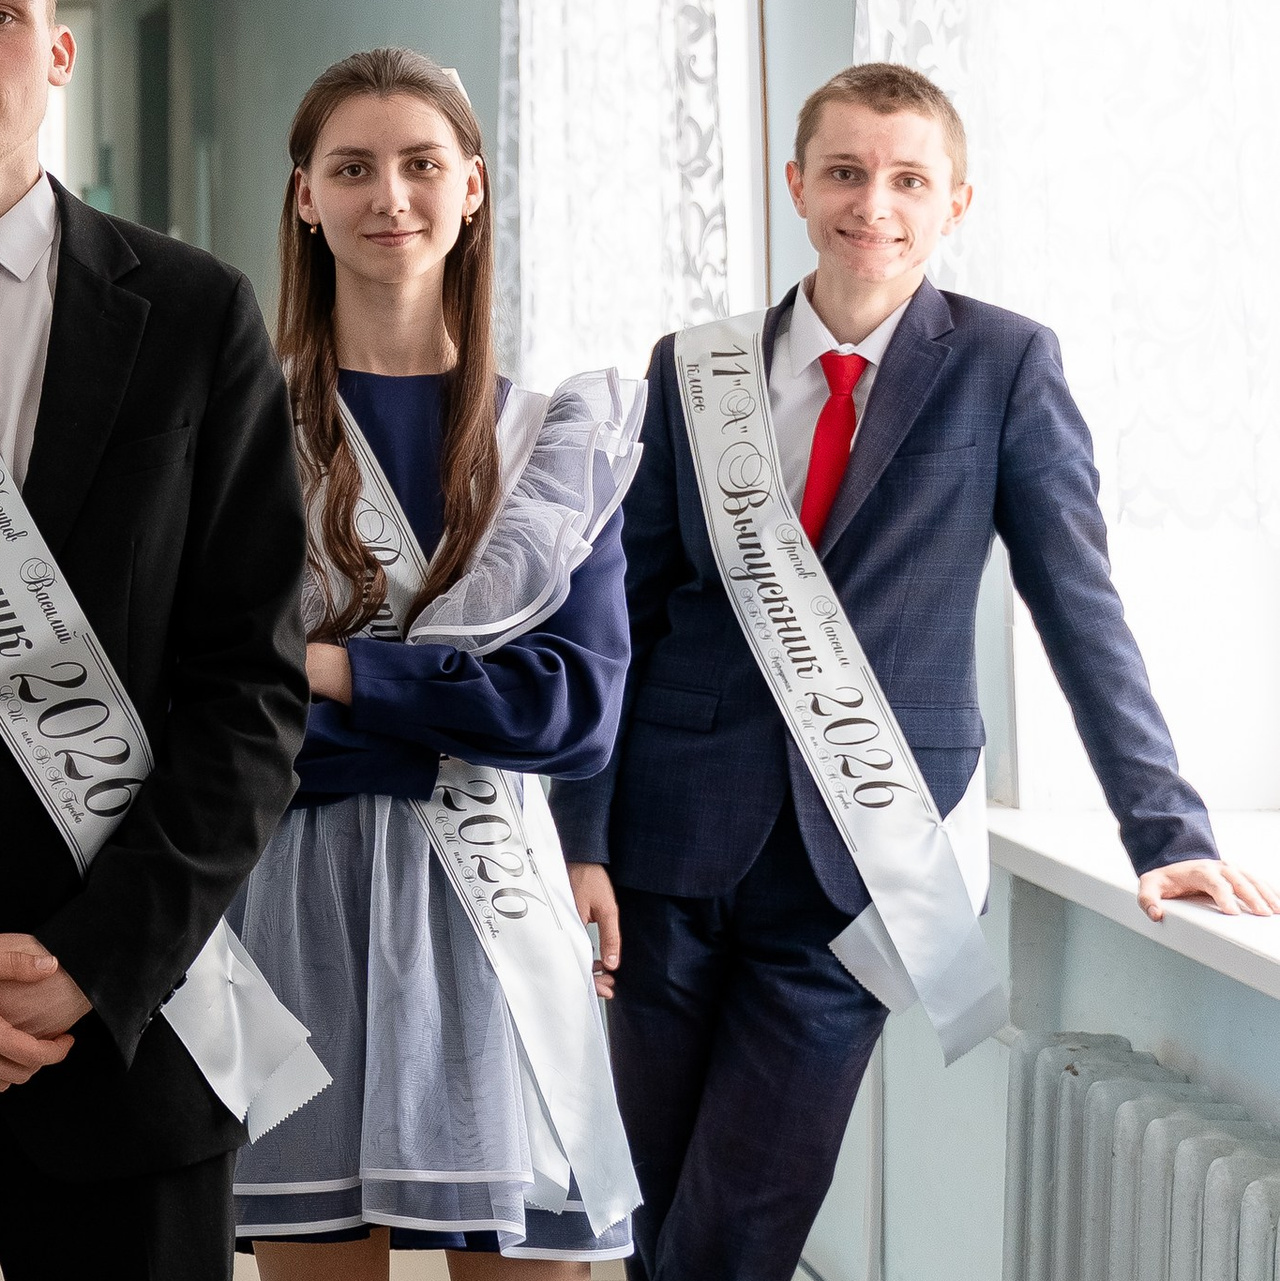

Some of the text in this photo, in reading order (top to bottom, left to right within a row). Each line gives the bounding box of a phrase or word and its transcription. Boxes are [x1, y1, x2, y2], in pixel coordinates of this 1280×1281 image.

[686, 363, 706, 414] класс
[20, 557, 79, 645] Василий
[717, 441, 917, 808] Выпускник 2026
[774, 522, 851, 668] Грачев Максим
[9, 661, 146, 818] 2026
[435, 779, 547, 919] 2026
